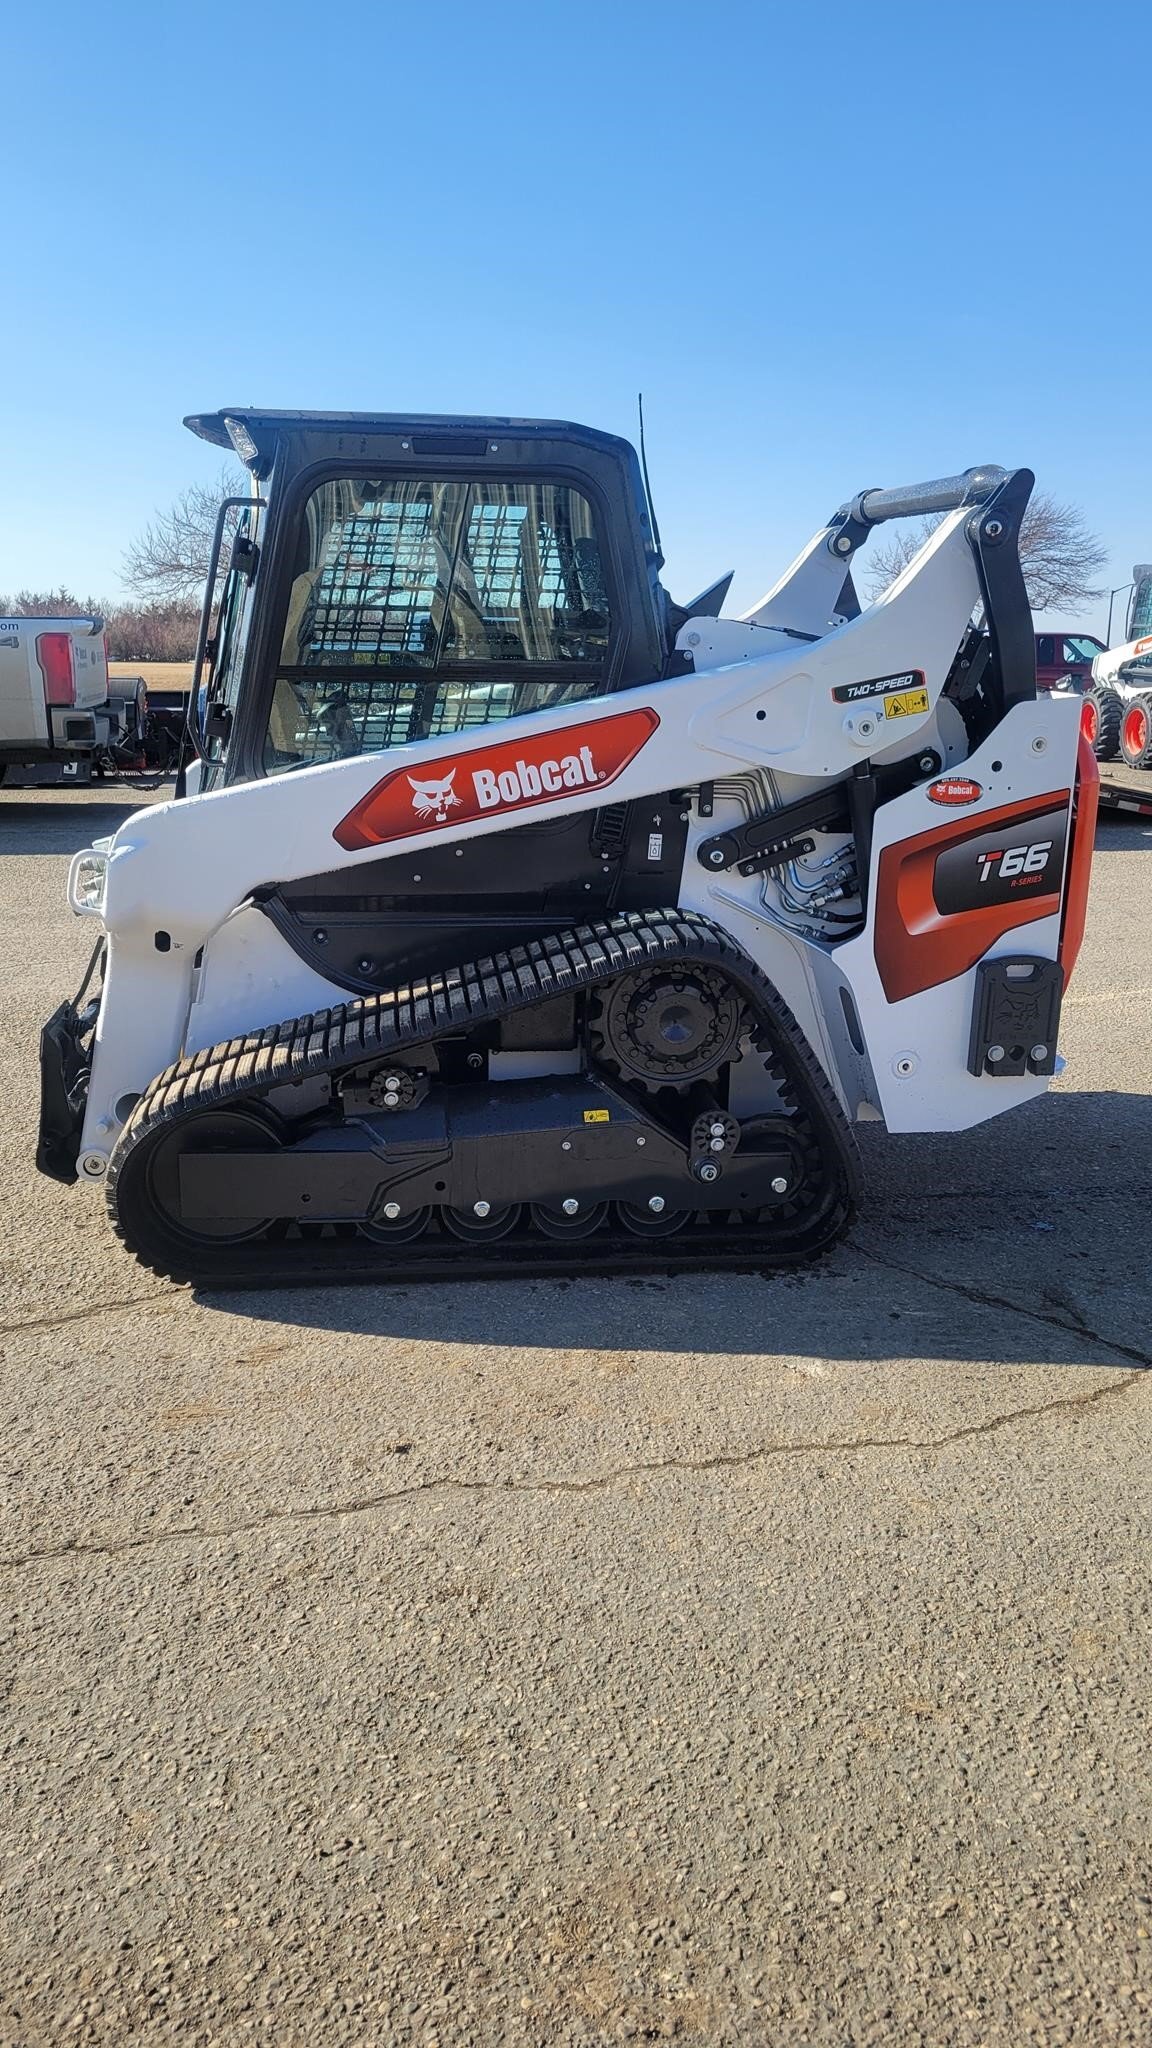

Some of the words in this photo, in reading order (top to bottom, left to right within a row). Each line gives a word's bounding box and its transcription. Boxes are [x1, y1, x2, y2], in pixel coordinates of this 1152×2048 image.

[847, 675, 913, 698] TWO-SPEED
[472, 746, 598, 809] Bobcat
[948, 785, 973, 795] Bobcat
[977, 841, 1053, 882] T66
[1010, 874, 1043, 888] R-SERIES
